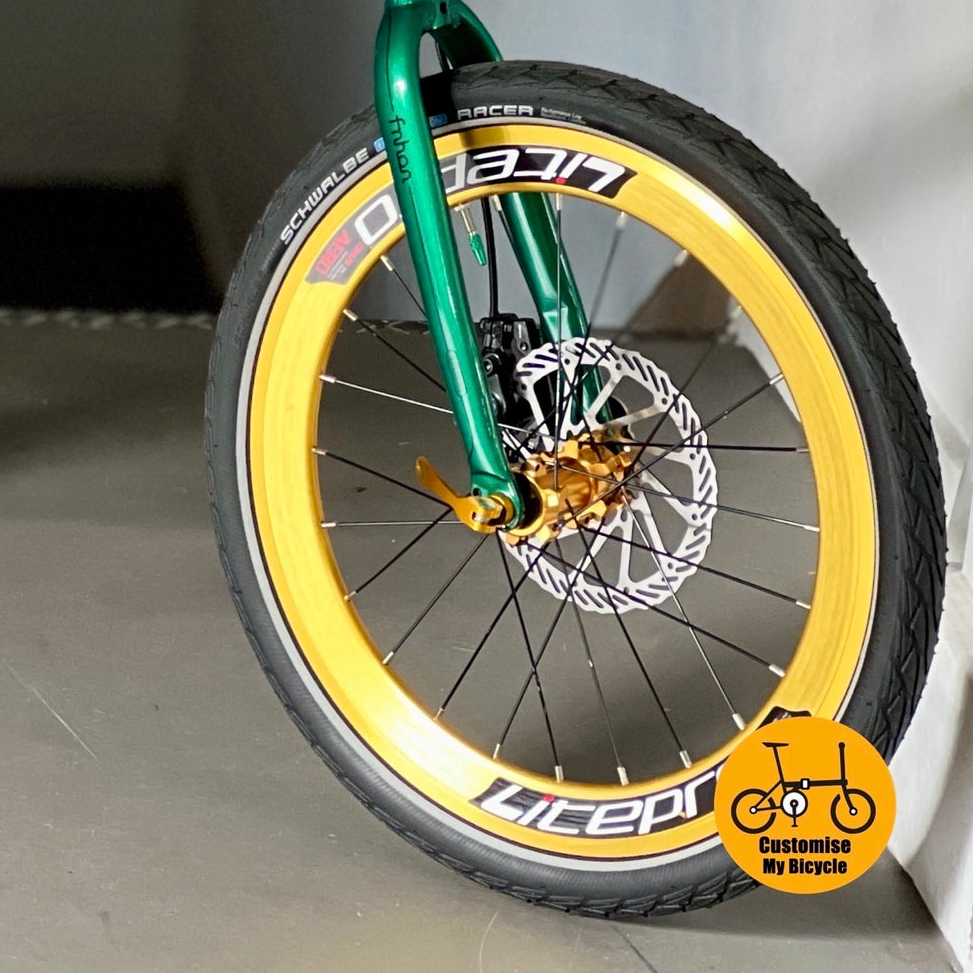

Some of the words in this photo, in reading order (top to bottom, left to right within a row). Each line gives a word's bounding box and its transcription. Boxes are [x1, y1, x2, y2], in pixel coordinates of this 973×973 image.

[457, 104, 534, 121] RACER
[280, 147, 369, 245] SCHWALBE
[481, 761, 726, 835] Litepr
